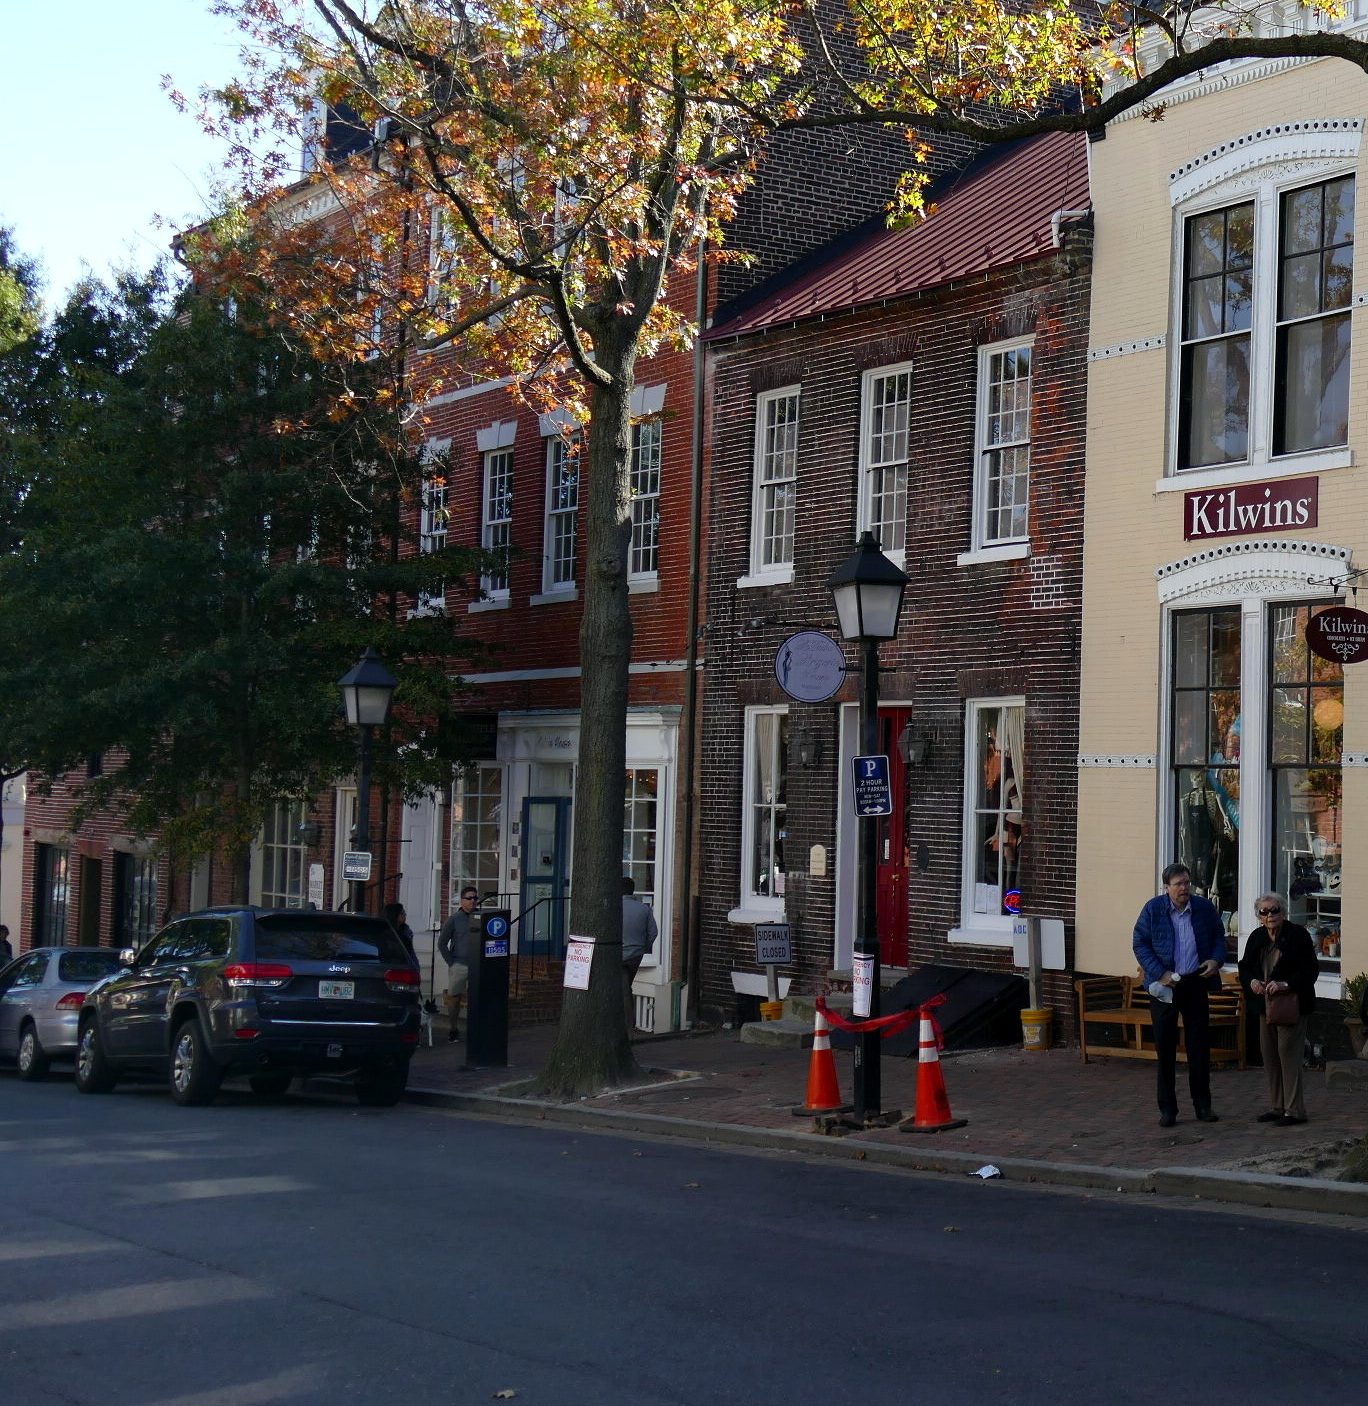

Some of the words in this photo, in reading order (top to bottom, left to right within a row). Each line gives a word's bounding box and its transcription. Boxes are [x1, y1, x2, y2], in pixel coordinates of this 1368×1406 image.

[1190, 488, 1311, 535] Kilwins
[865, 760, 876, 777] P
[758, 930, 788, 942] SIDEWALK
[762, 947, 787, 958] CLOSED
[567, 954, 590, 964] PARKING
[329, 965, 351, 973] Jeep
